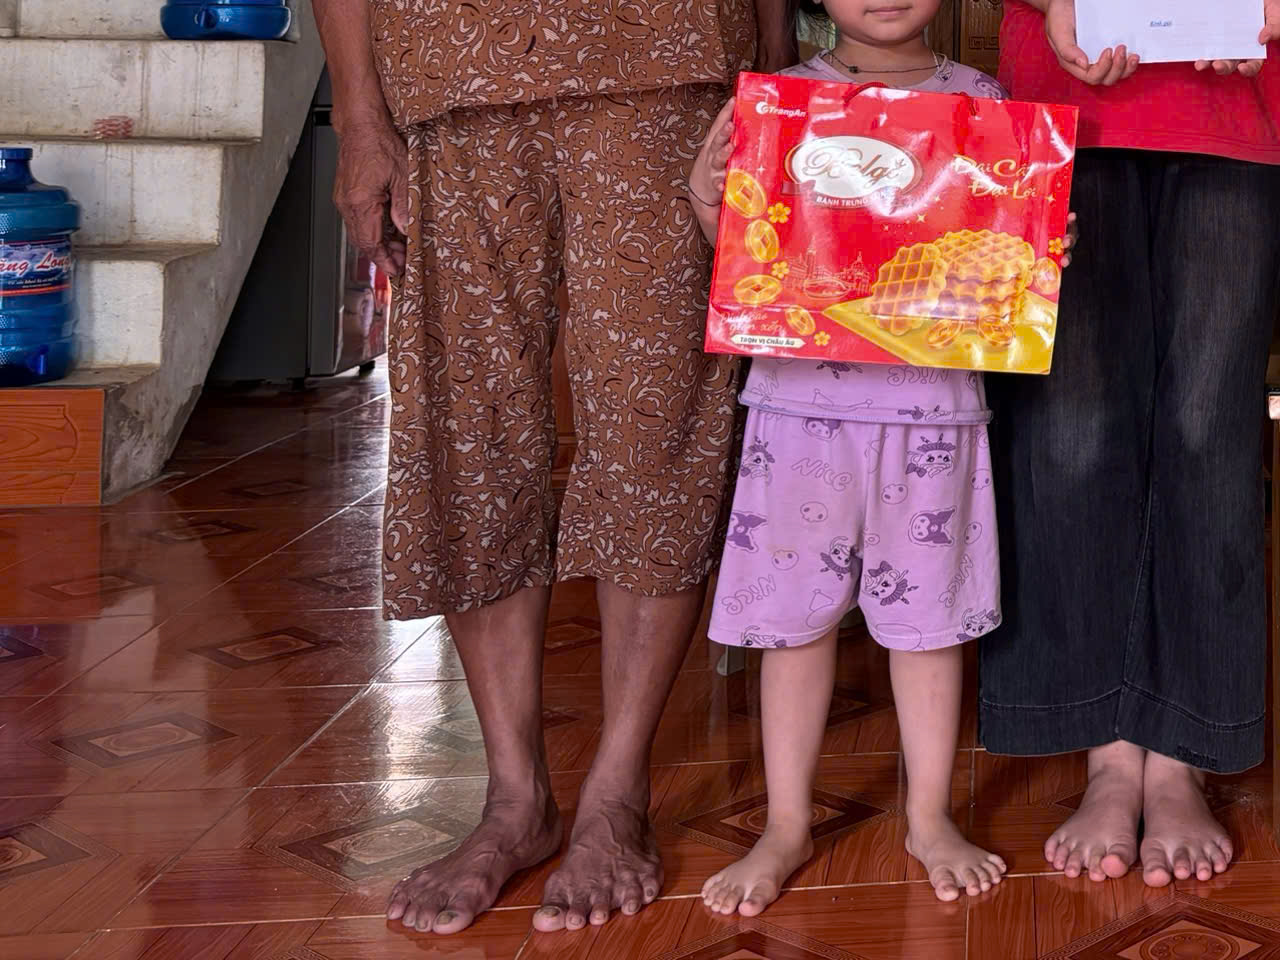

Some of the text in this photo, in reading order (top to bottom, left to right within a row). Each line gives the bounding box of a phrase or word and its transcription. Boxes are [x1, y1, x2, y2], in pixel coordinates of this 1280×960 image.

[0, 250, 71, 277] ăng Long
[791, 457, 853, 491] Nice
[721, 573, 777, 615] Nice
[938, 554, 974, 608] Nice
